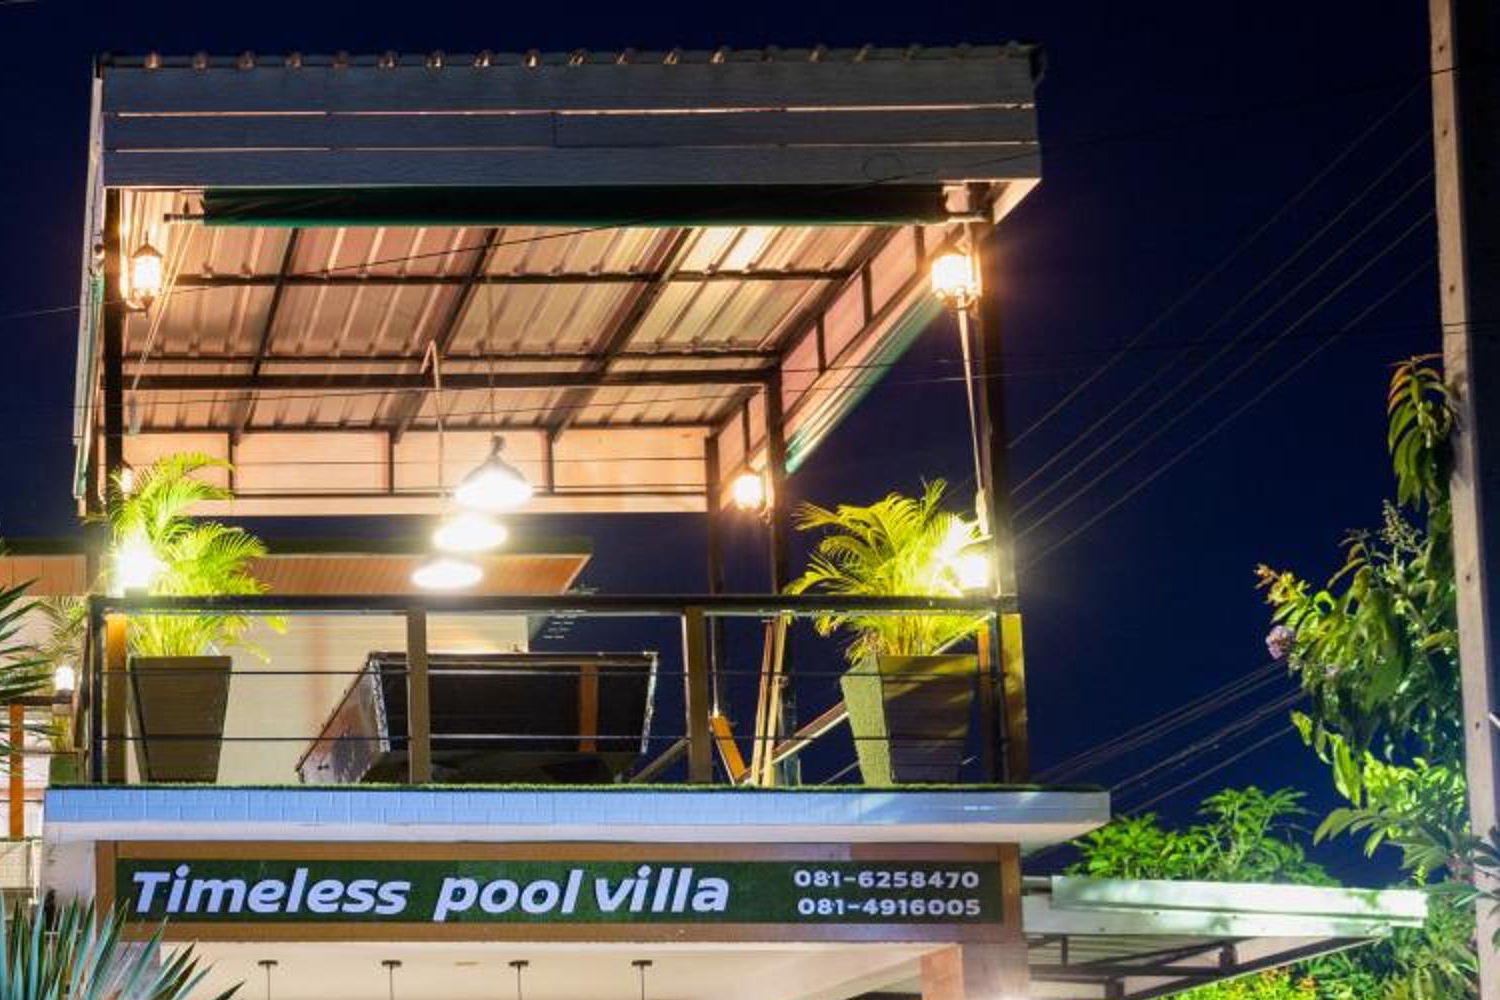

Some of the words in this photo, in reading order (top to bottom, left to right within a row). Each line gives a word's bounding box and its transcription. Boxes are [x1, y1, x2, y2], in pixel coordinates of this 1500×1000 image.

[793, 870, 979, 889] 081-6258470
[132, 863, 411, 915] Timeless
[432, 869, 583, 922] pool
[595, 865, 730, 913] villa
[797, 898, 981, 917] 081-4916005
